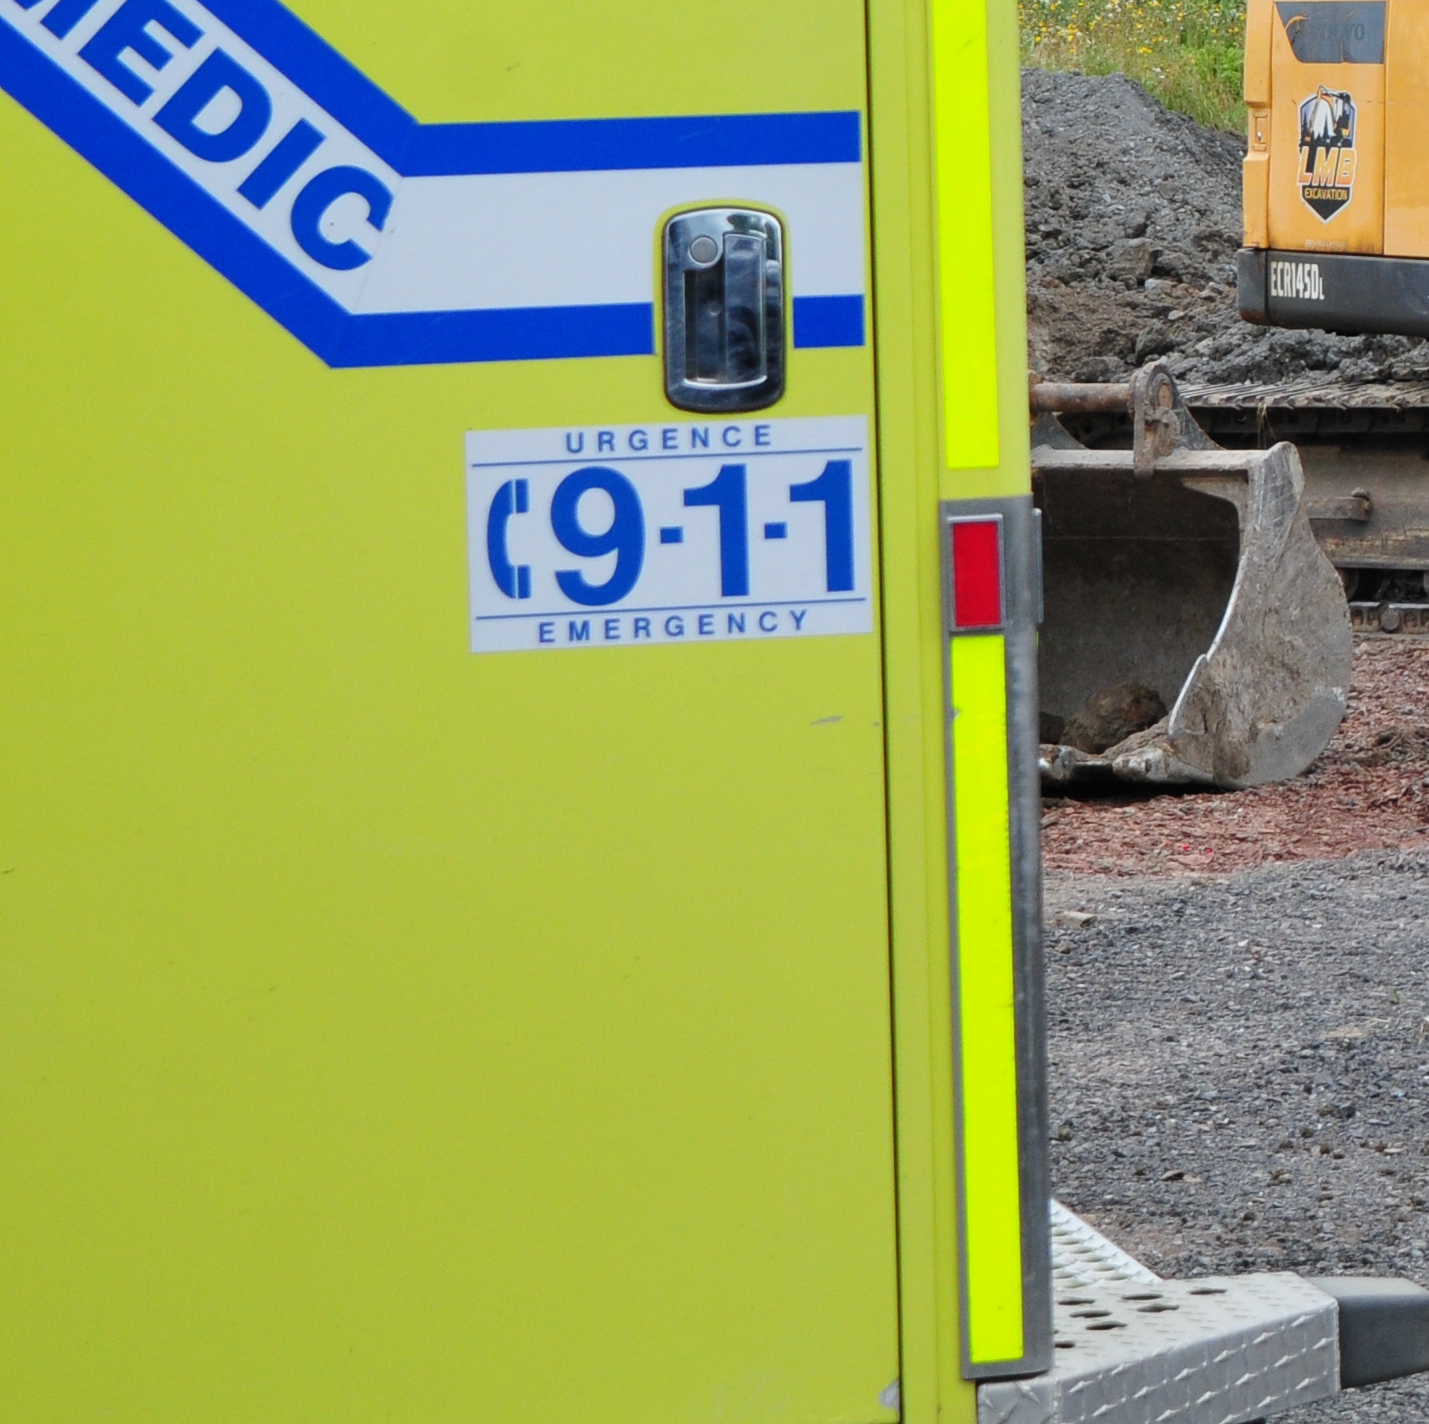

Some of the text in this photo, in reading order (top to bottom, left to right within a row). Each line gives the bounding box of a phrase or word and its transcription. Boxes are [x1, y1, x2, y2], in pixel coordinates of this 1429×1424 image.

[1298, 146, 1357, 187] LMB
[1304, 188, 1348, 200] EXCAVATION
[566, 424, 771, 453] URGENCE
[551, 459, 855, 606] 9-1-1
[538, 609, 807, 643] EMERGENCY
